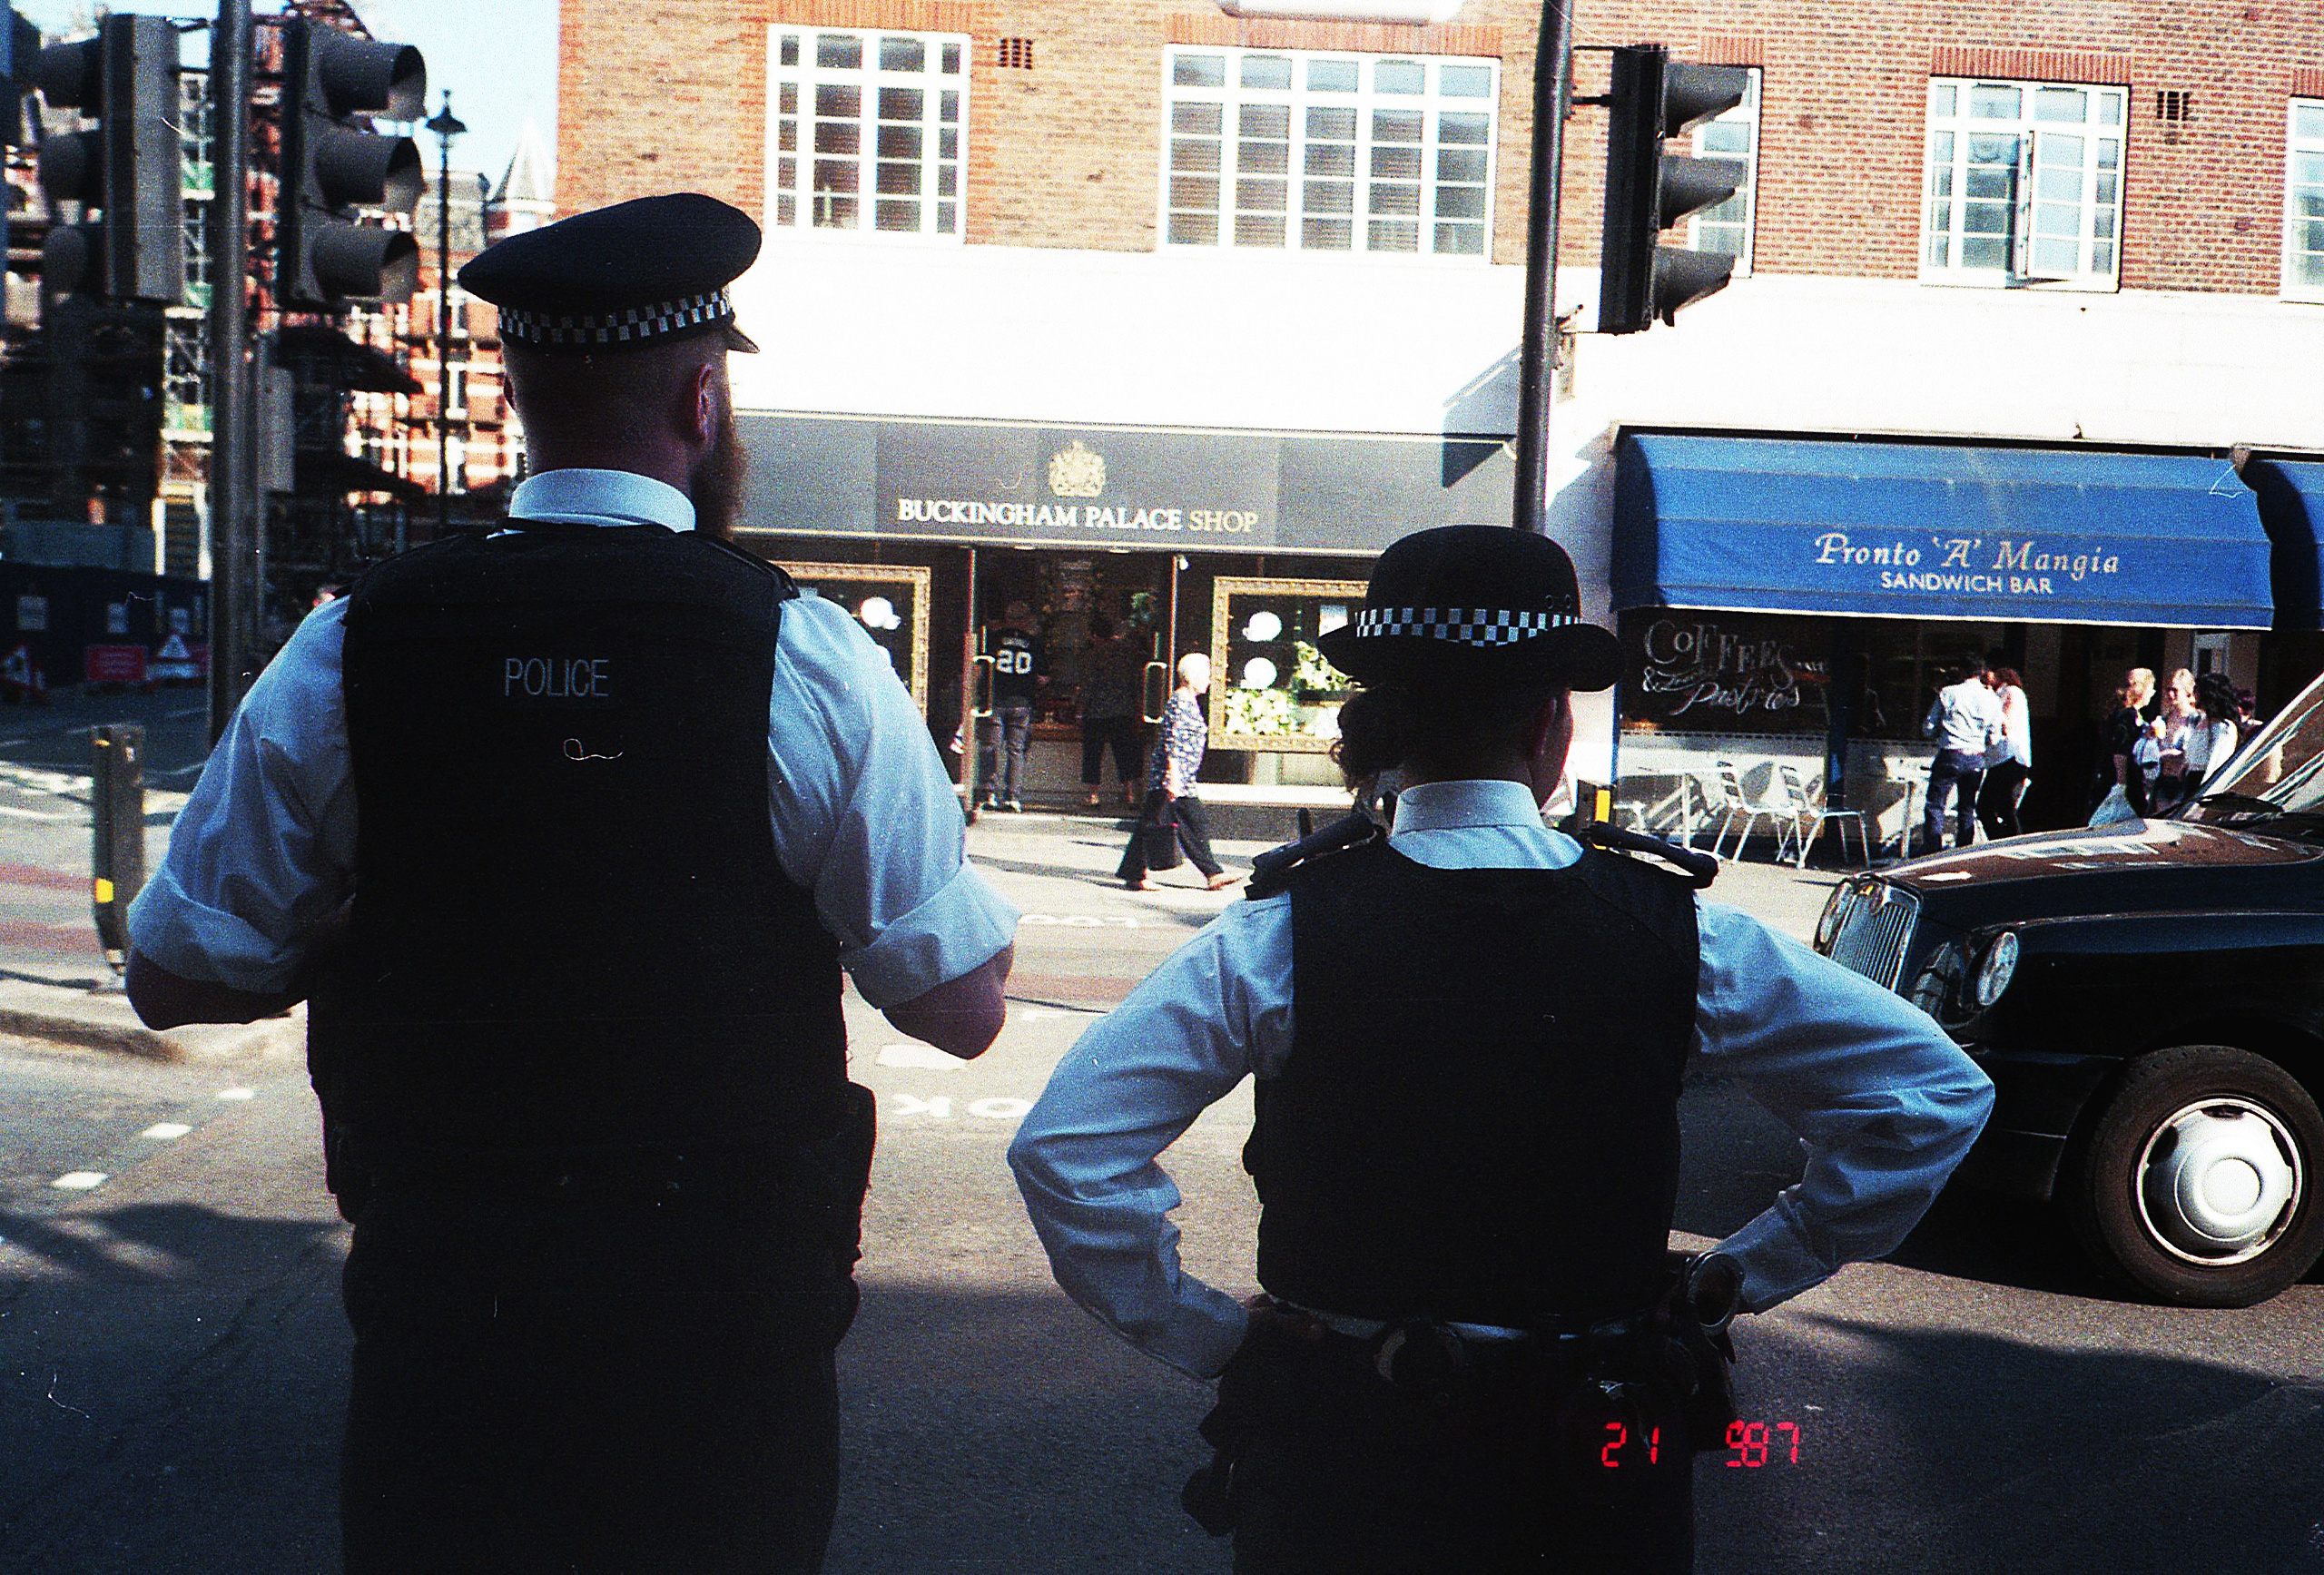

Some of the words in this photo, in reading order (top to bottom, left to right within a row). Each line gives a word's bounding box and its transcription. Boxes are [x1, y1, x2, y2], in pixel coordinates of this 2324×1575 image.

[898, 498, 1077, 527] BUCKINGHAM
[1084, 506, 1182, 530] PALACE
[1189, 509, 1258, 533] SHOP
[1815, 533, 1920, 566] Pronto
[1992, 540, 2119, 581] Mangia
[1880, 571, 2003, 592] SANDWICH
[2009, 576, 2053, 595] BAR
[505, 657, 609, 696] POLICE
[997, 649, 1031, 674] 20
